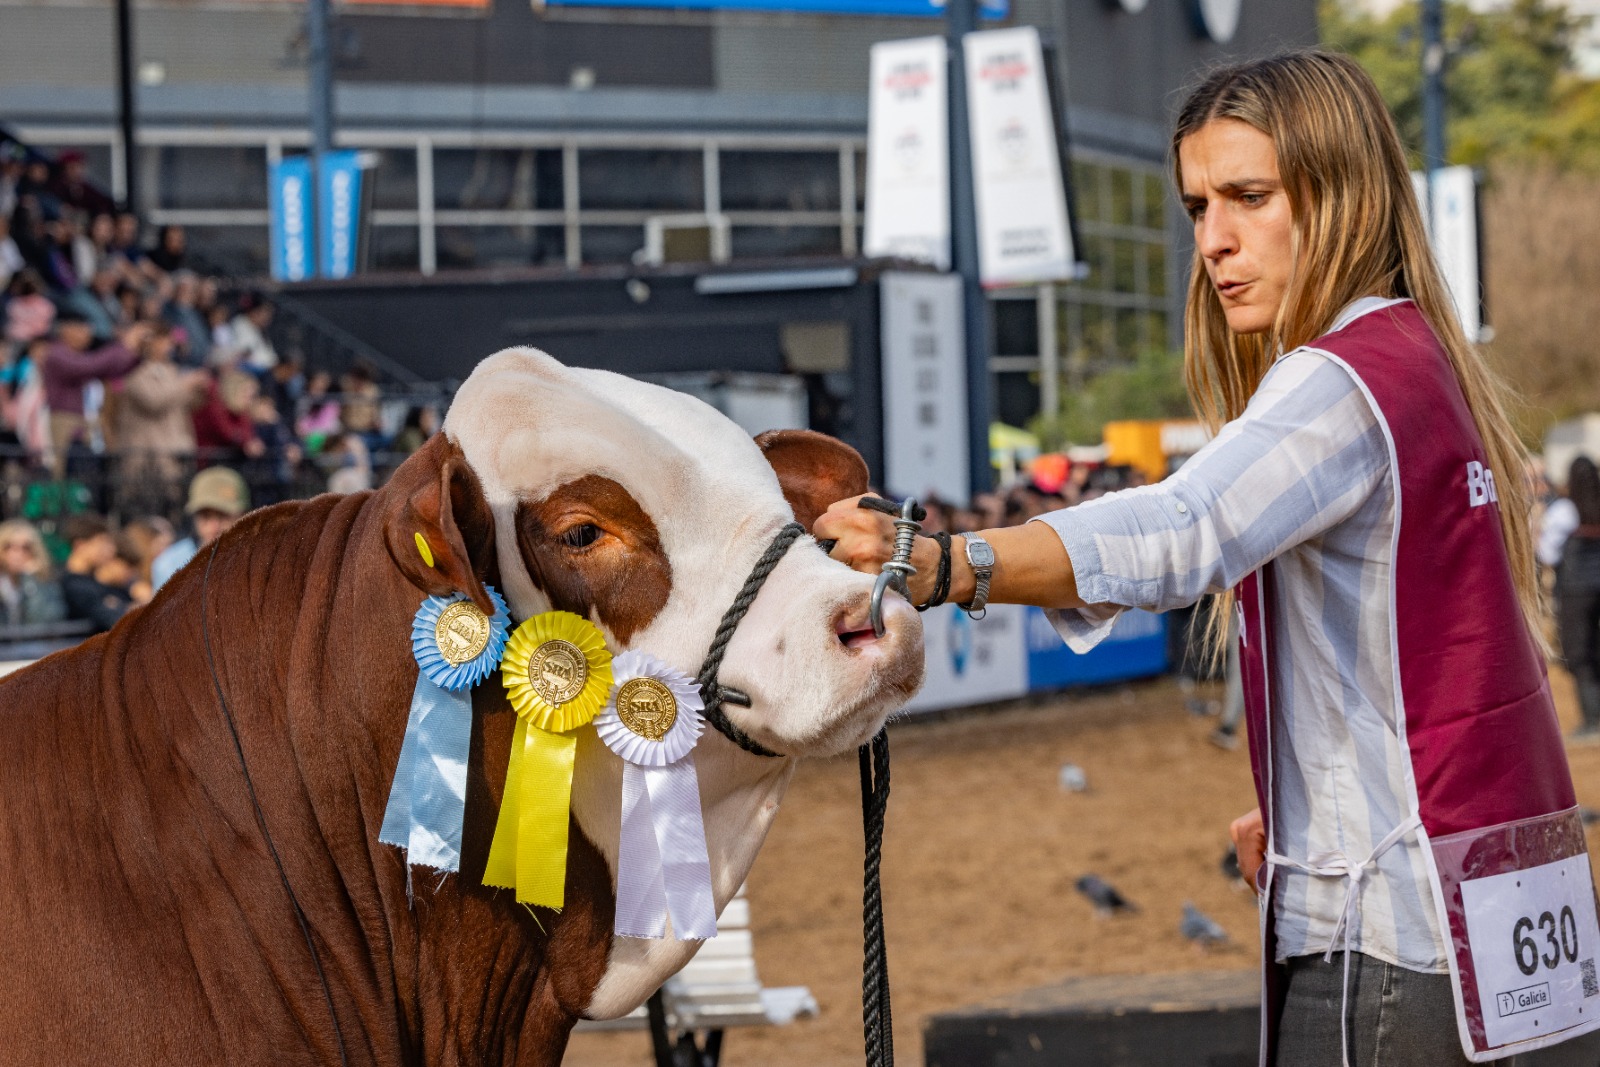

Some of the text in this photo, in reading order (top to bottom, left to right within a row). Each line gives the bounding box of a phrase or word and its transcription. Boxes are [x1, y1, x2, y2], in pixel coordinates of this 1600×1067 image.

[543, 661, 572, 681] SRA
[629, 700, 664, 713] SRA
[1513, 905, 1578, 976] 630
[1518, 989, 1547, 1007] Galicia
